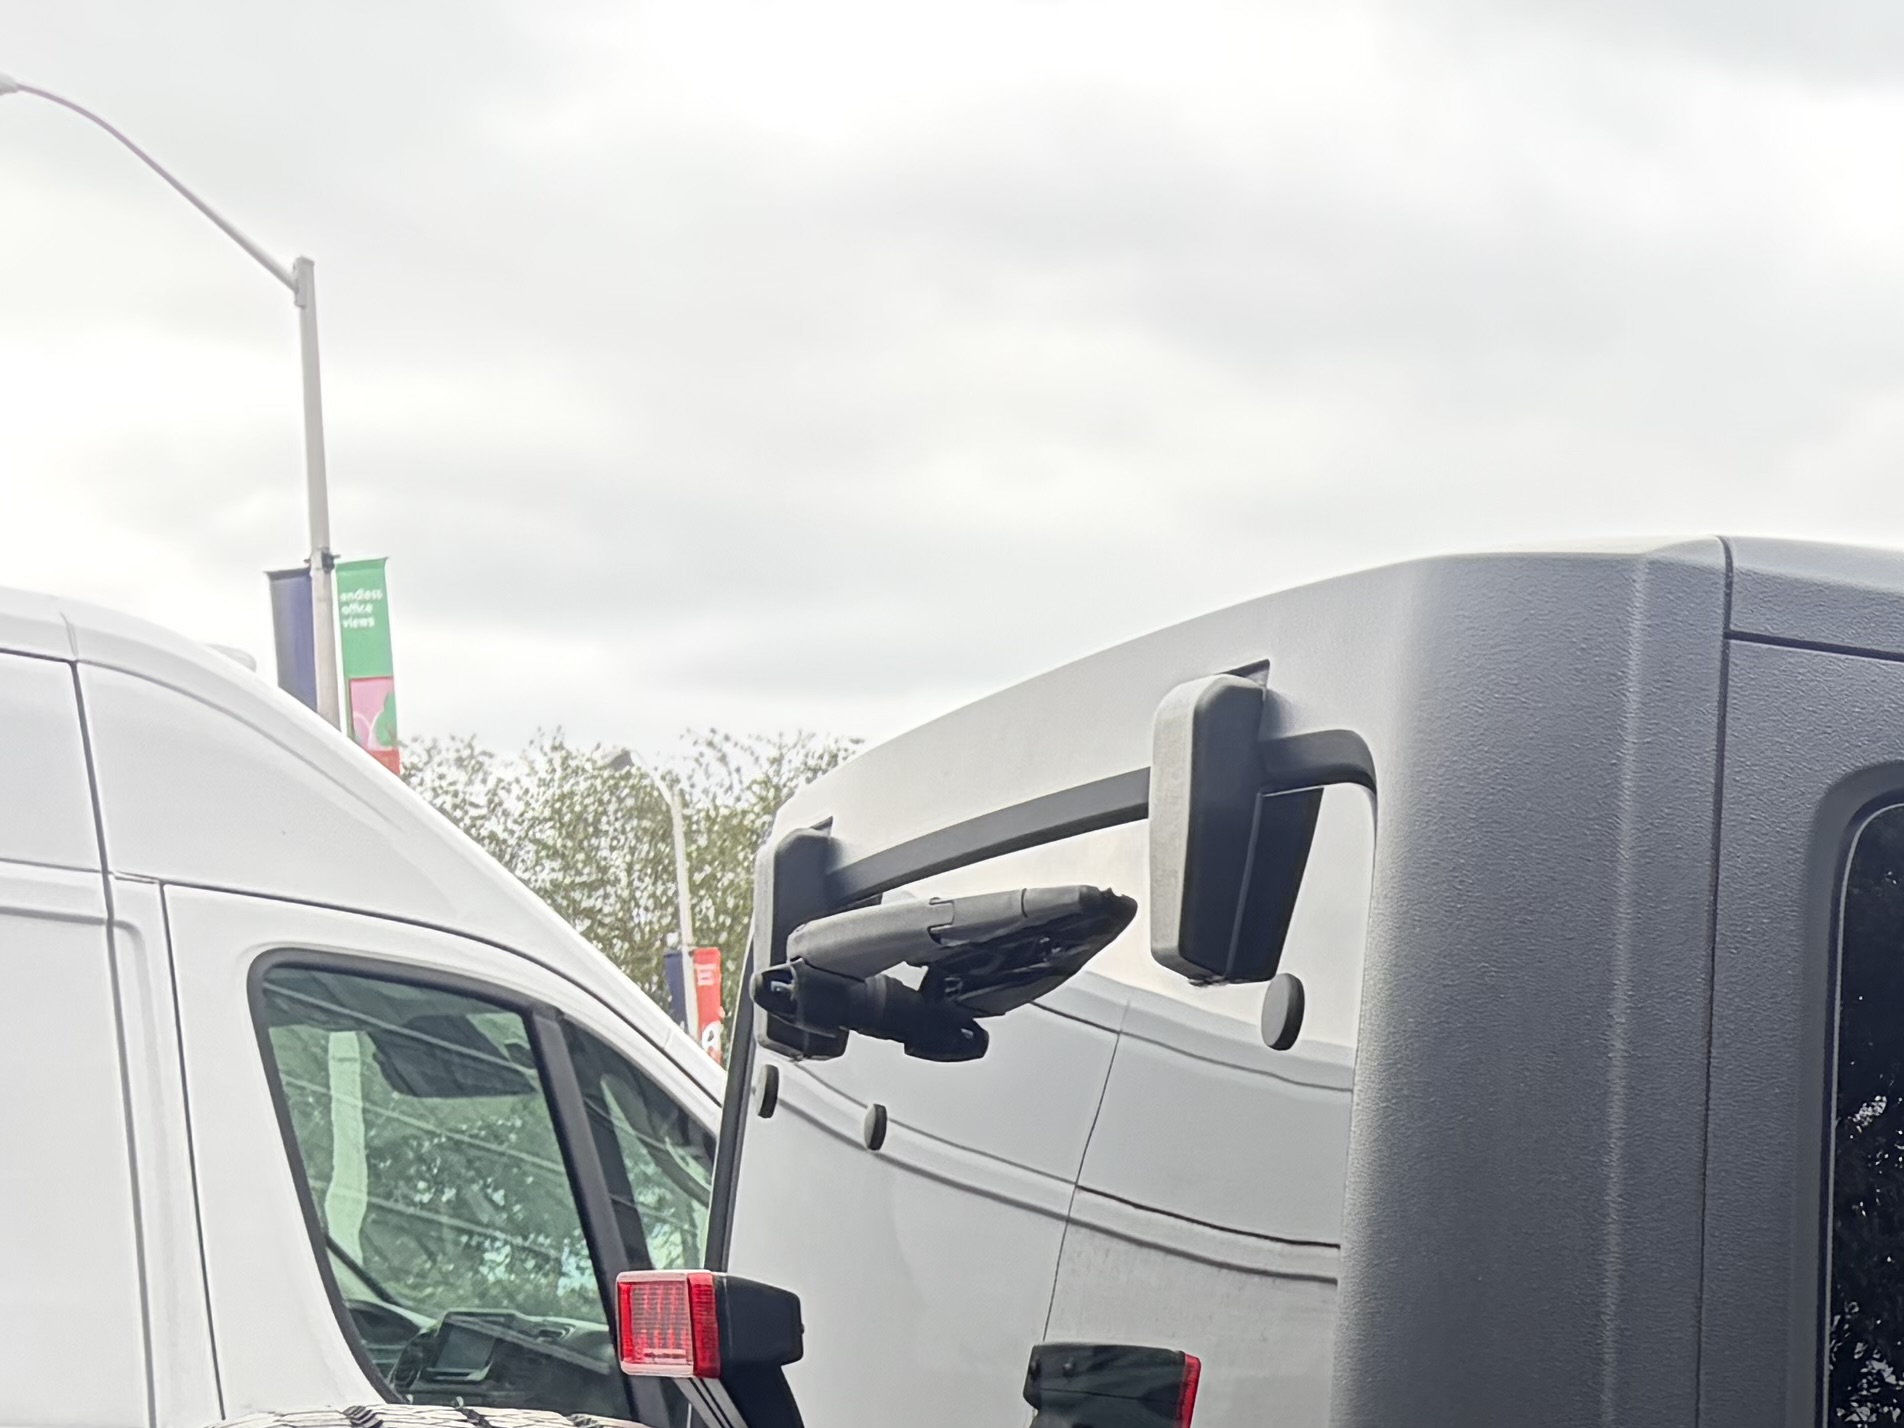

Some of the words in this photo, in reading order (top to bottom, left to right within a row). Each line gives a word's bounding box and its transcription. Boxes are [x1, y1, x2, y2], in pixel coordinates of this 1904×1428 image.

[341, 588, 383, 601] endless
[341, 602, 373, 614] office
[342, 617, 375, 629] views
